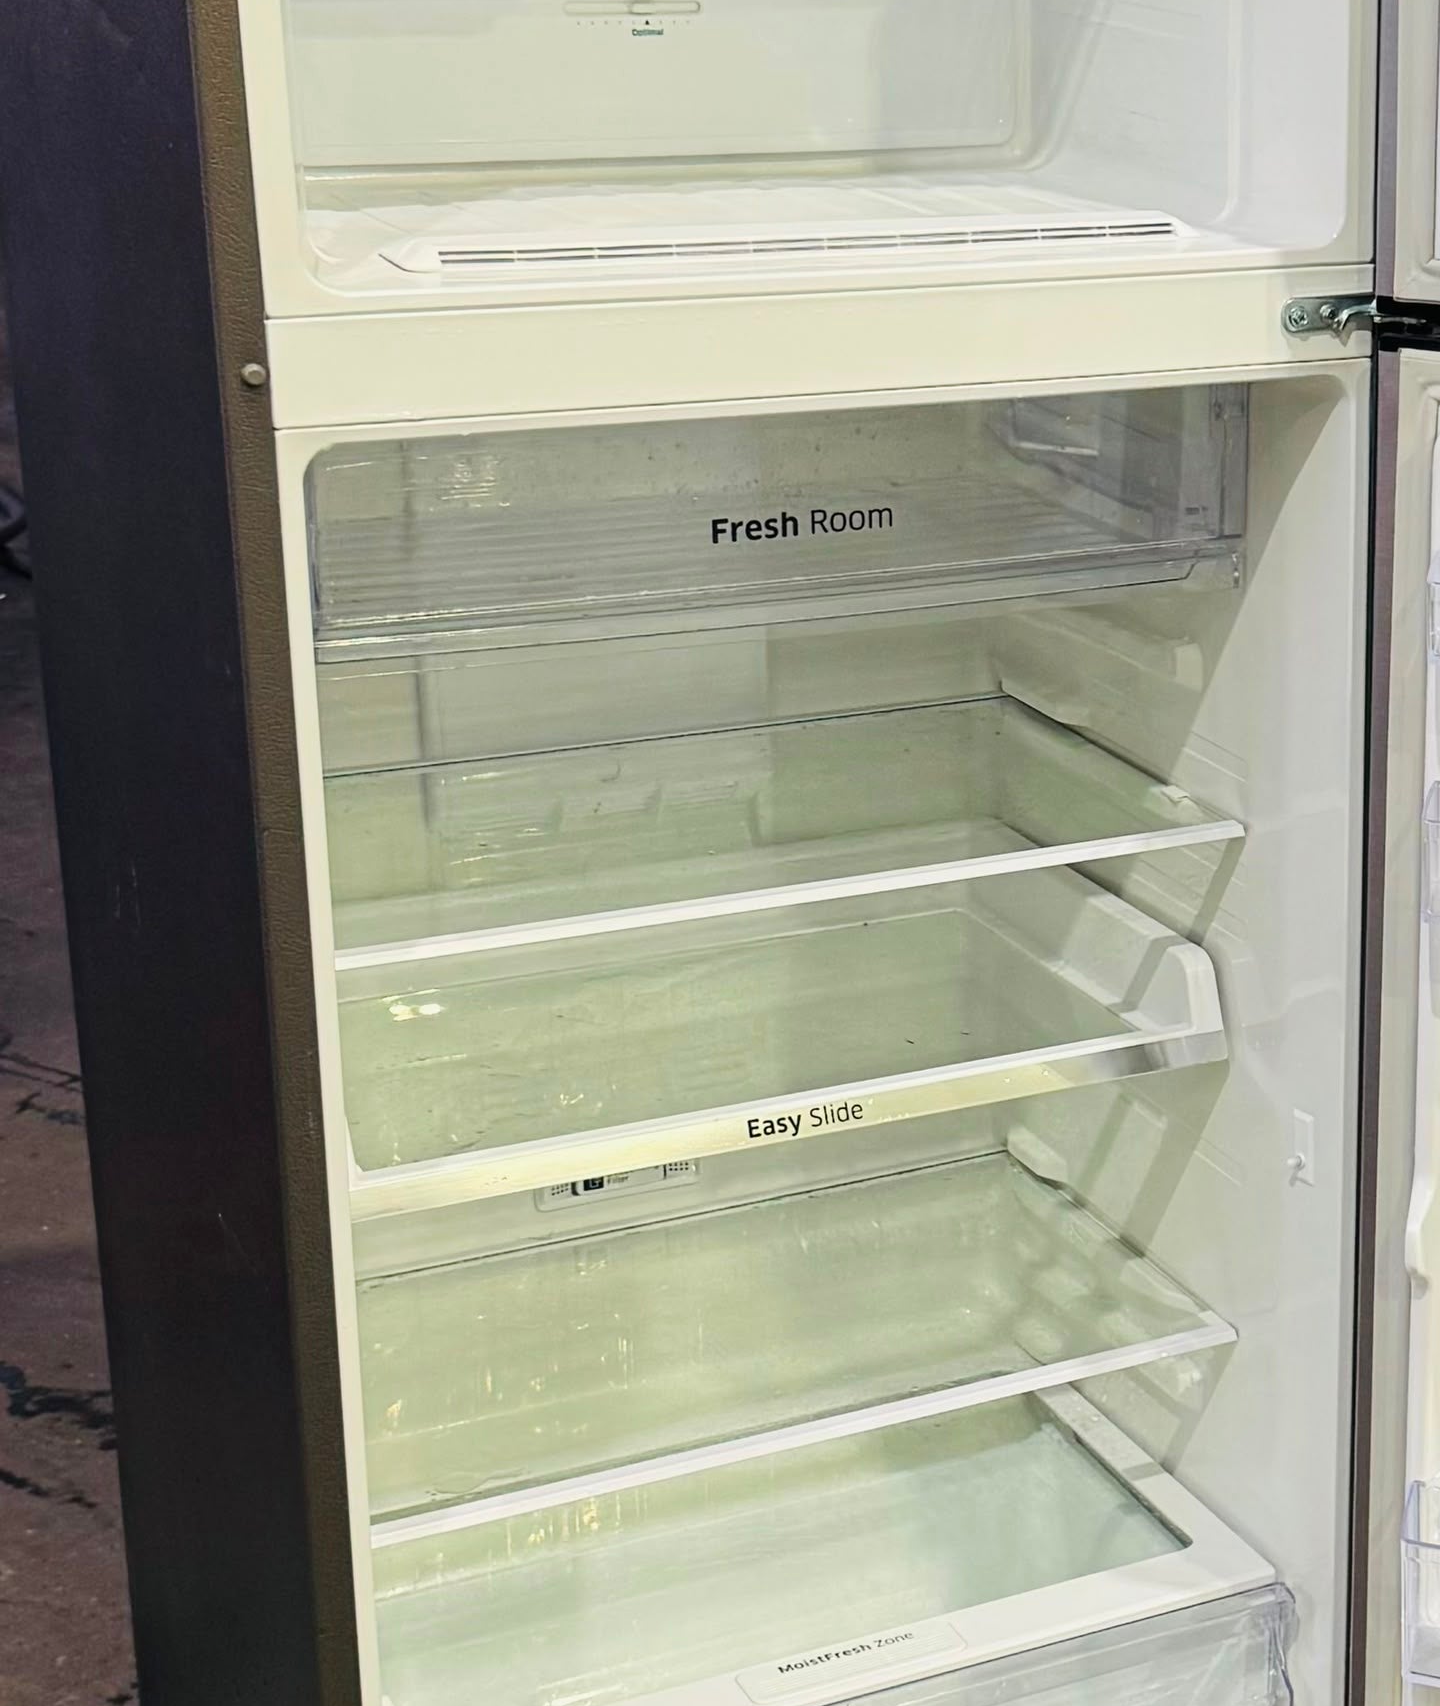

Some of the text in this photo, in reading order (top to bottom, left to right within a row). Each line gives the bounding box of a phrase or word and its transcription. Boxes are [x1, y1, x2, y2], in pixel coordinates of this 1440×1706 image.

[711, 507, 893, 544] Fresh Room
[747, 1101, 864, 1138] Easy Slide
[777, 1631, 915, 1674] MoistFresh Zone
